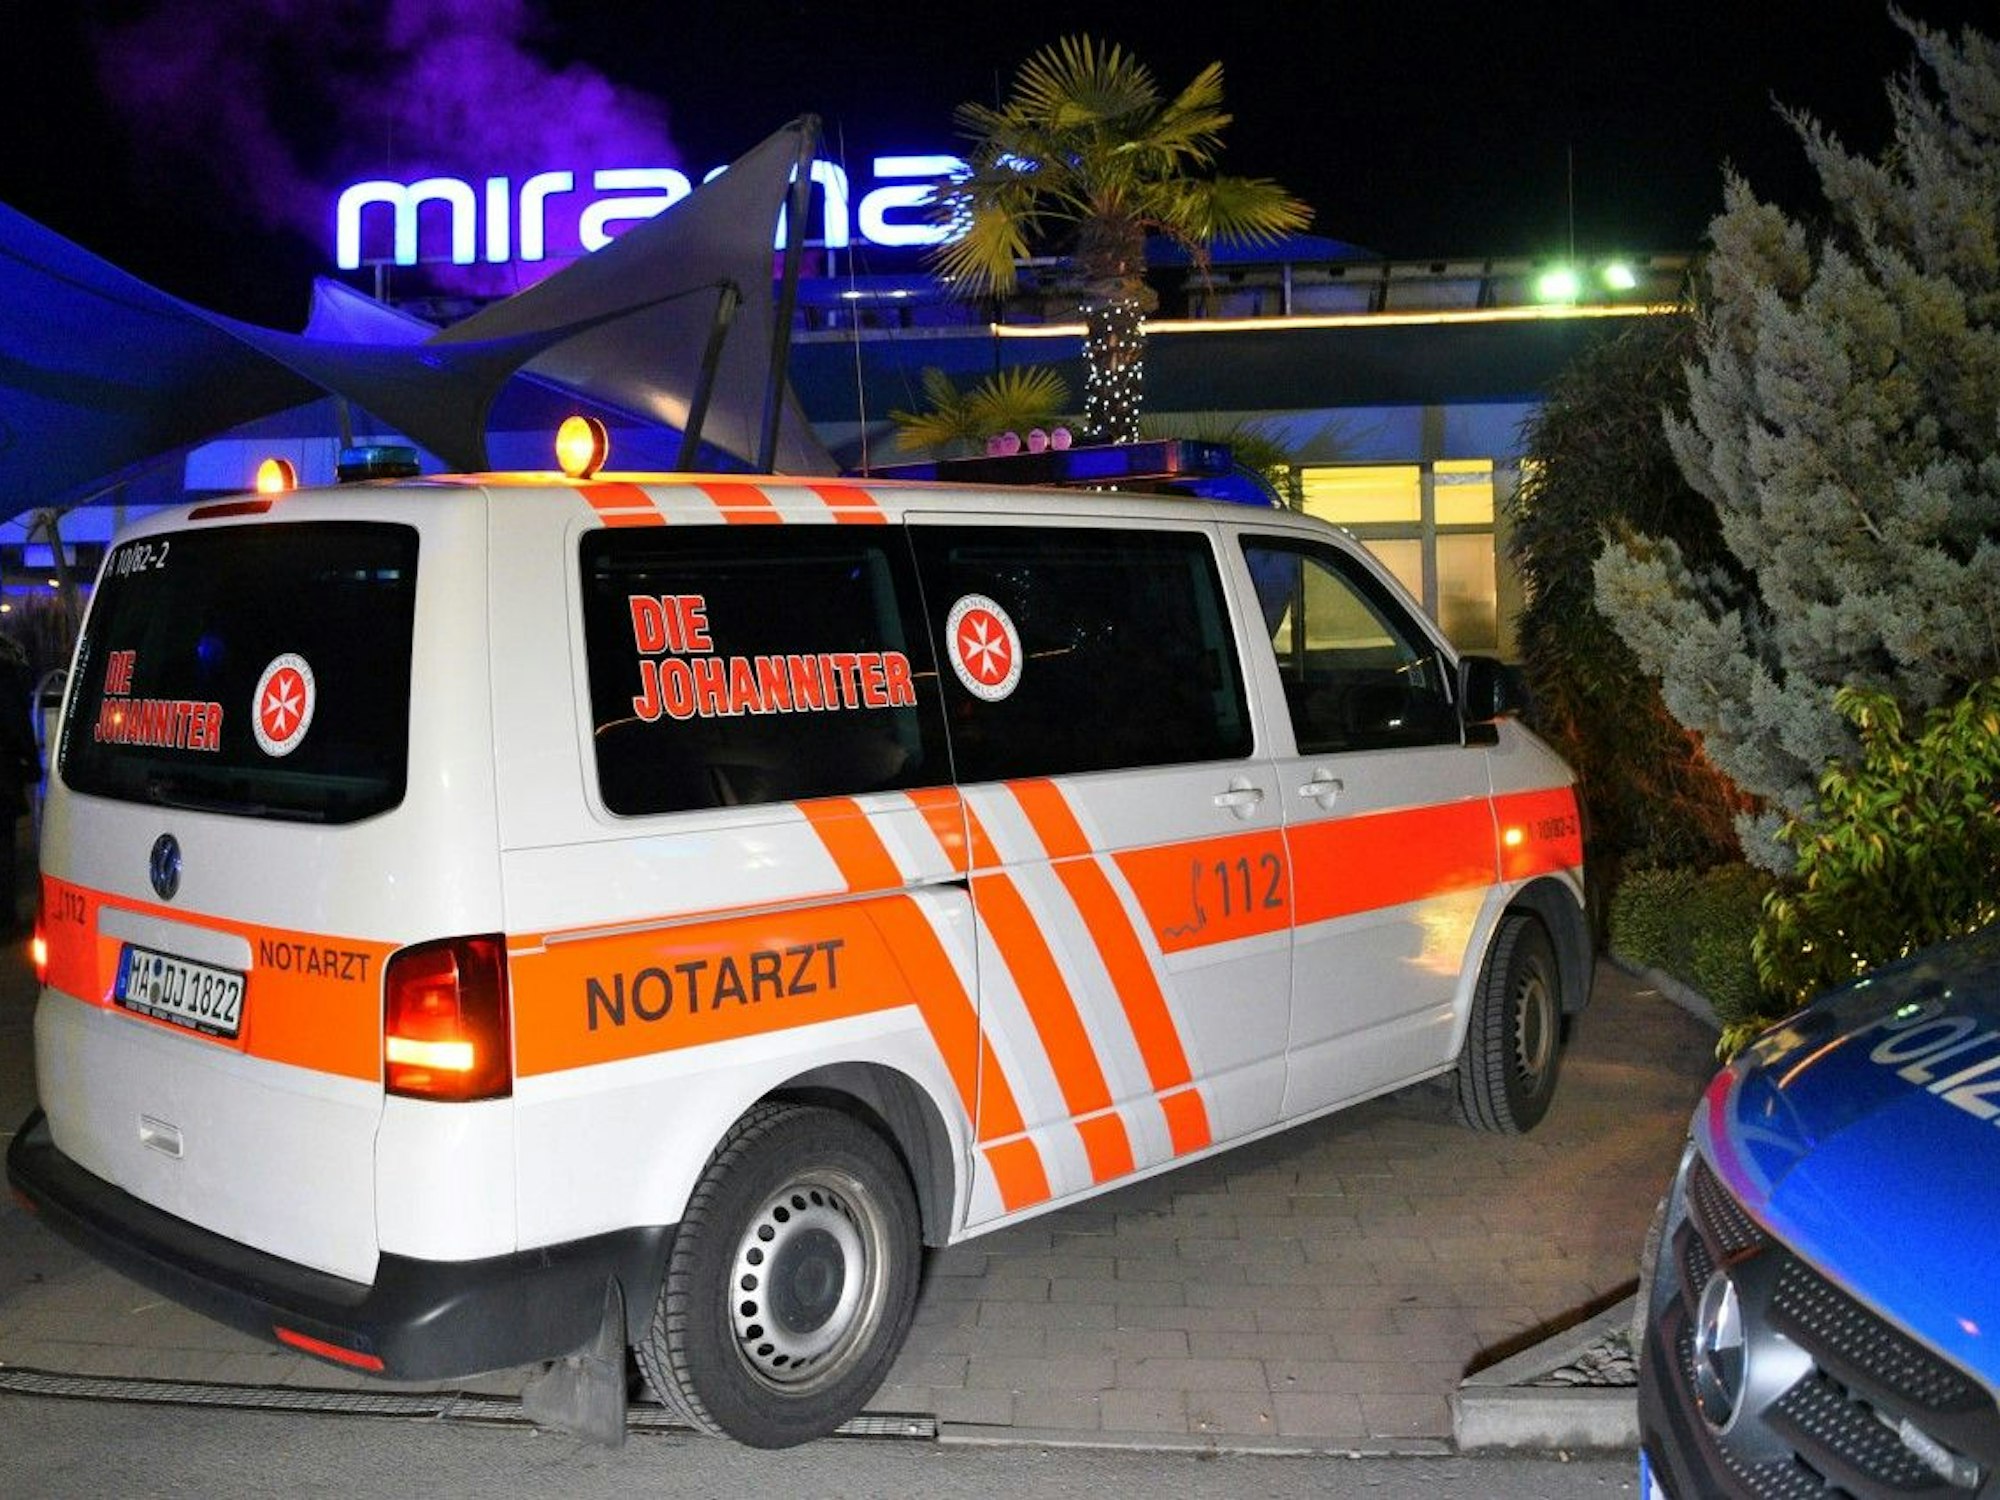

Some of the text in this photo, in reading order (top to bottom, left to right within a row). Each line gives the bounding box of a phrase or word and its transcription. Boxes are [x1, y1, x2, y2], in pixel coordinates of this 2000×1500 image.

[336, 154, 1042, 269] miraa
[628, 594, 714, 654] DIE
[104, 650, 136, 695] DIE
[633, 651, 917, 722] JOHANNITER
[94, 697, 223, 752] JOHANNITER
[65, 892, 86, 926] 112
[1214, 852, 1283, 917] 112
[260, 939, 371, 983] NOTARZT
[586, 938, 845, 1031] NOTARZT
[188, 971, 239, 1022] 1822
[1846, 998, 2000, 1128] POLIZ
